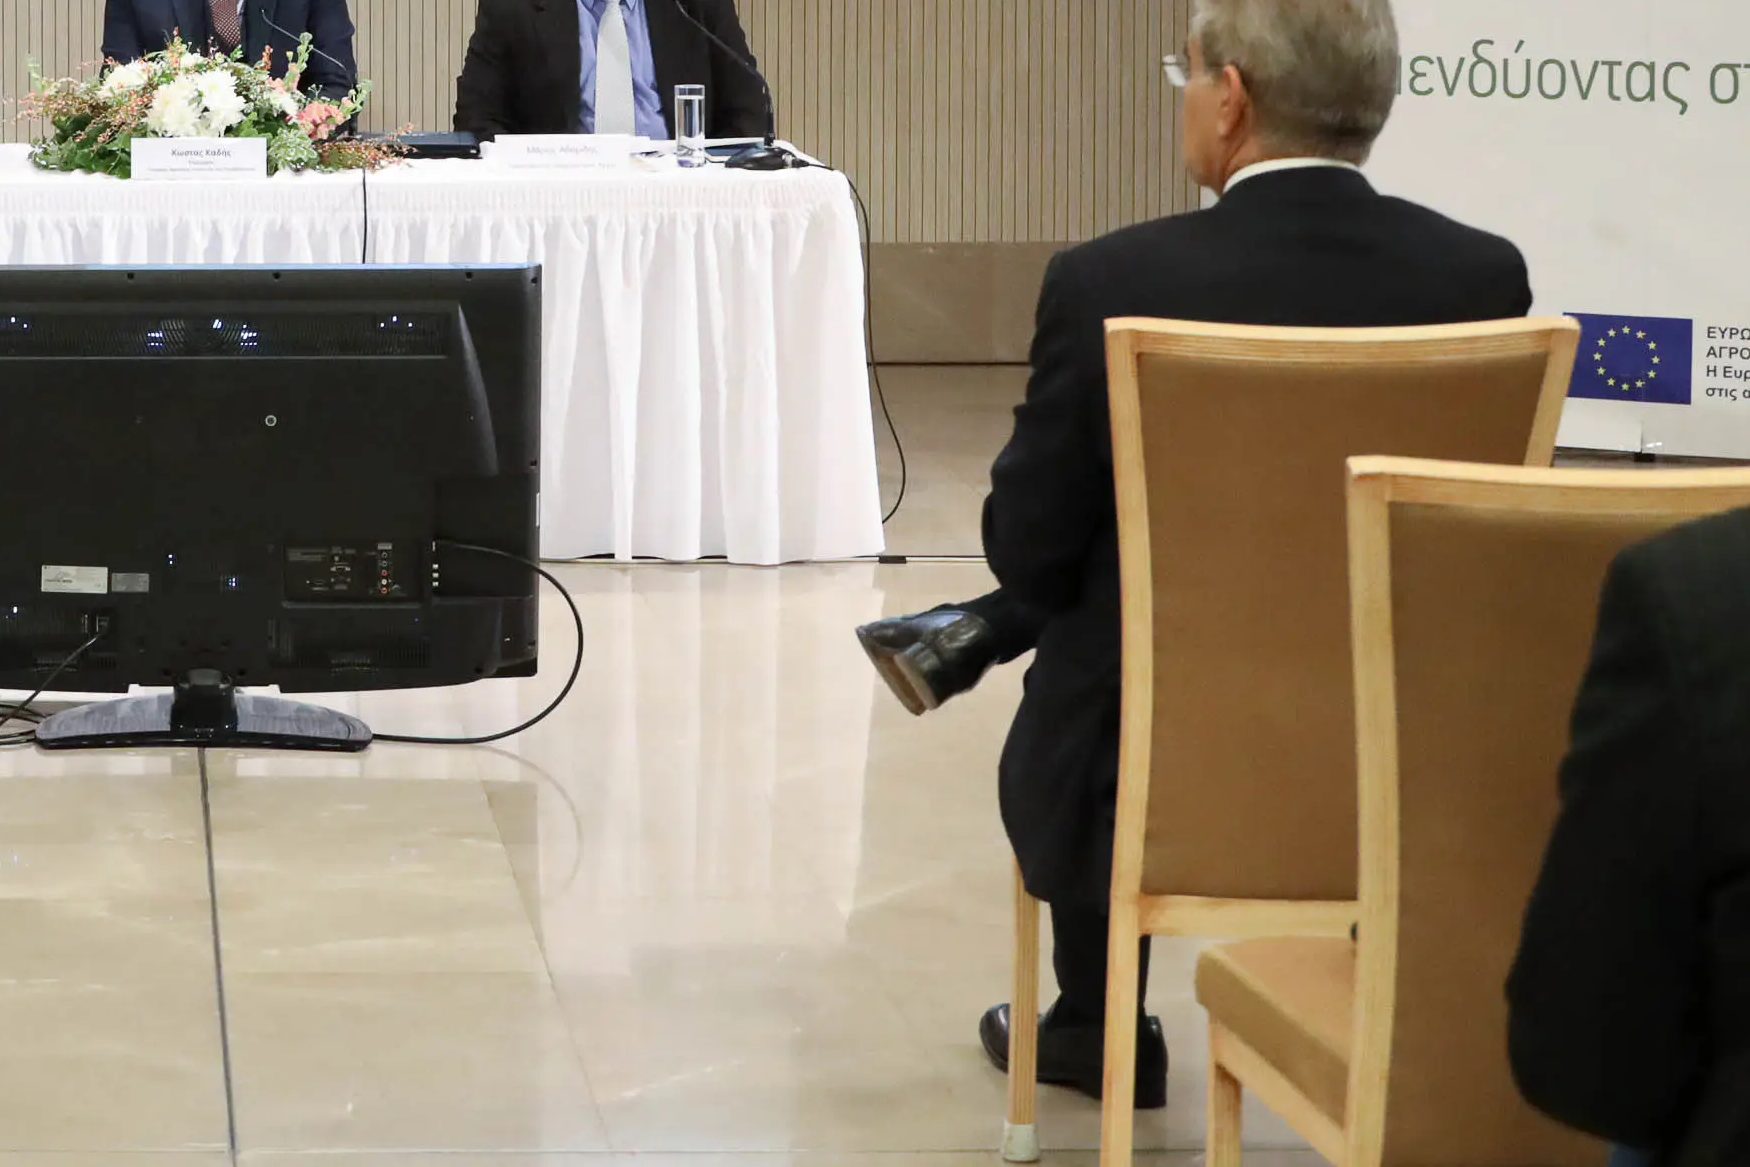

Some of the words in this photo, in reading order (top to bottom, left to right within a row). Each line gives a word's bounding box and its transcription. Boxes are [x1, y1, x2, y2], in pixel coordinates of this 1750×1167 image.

[1397, 39, 1691, 116] ενδύοντας
[1706, 365, 1717, 378] Η
[1706, 387, 1738, 401] στις
